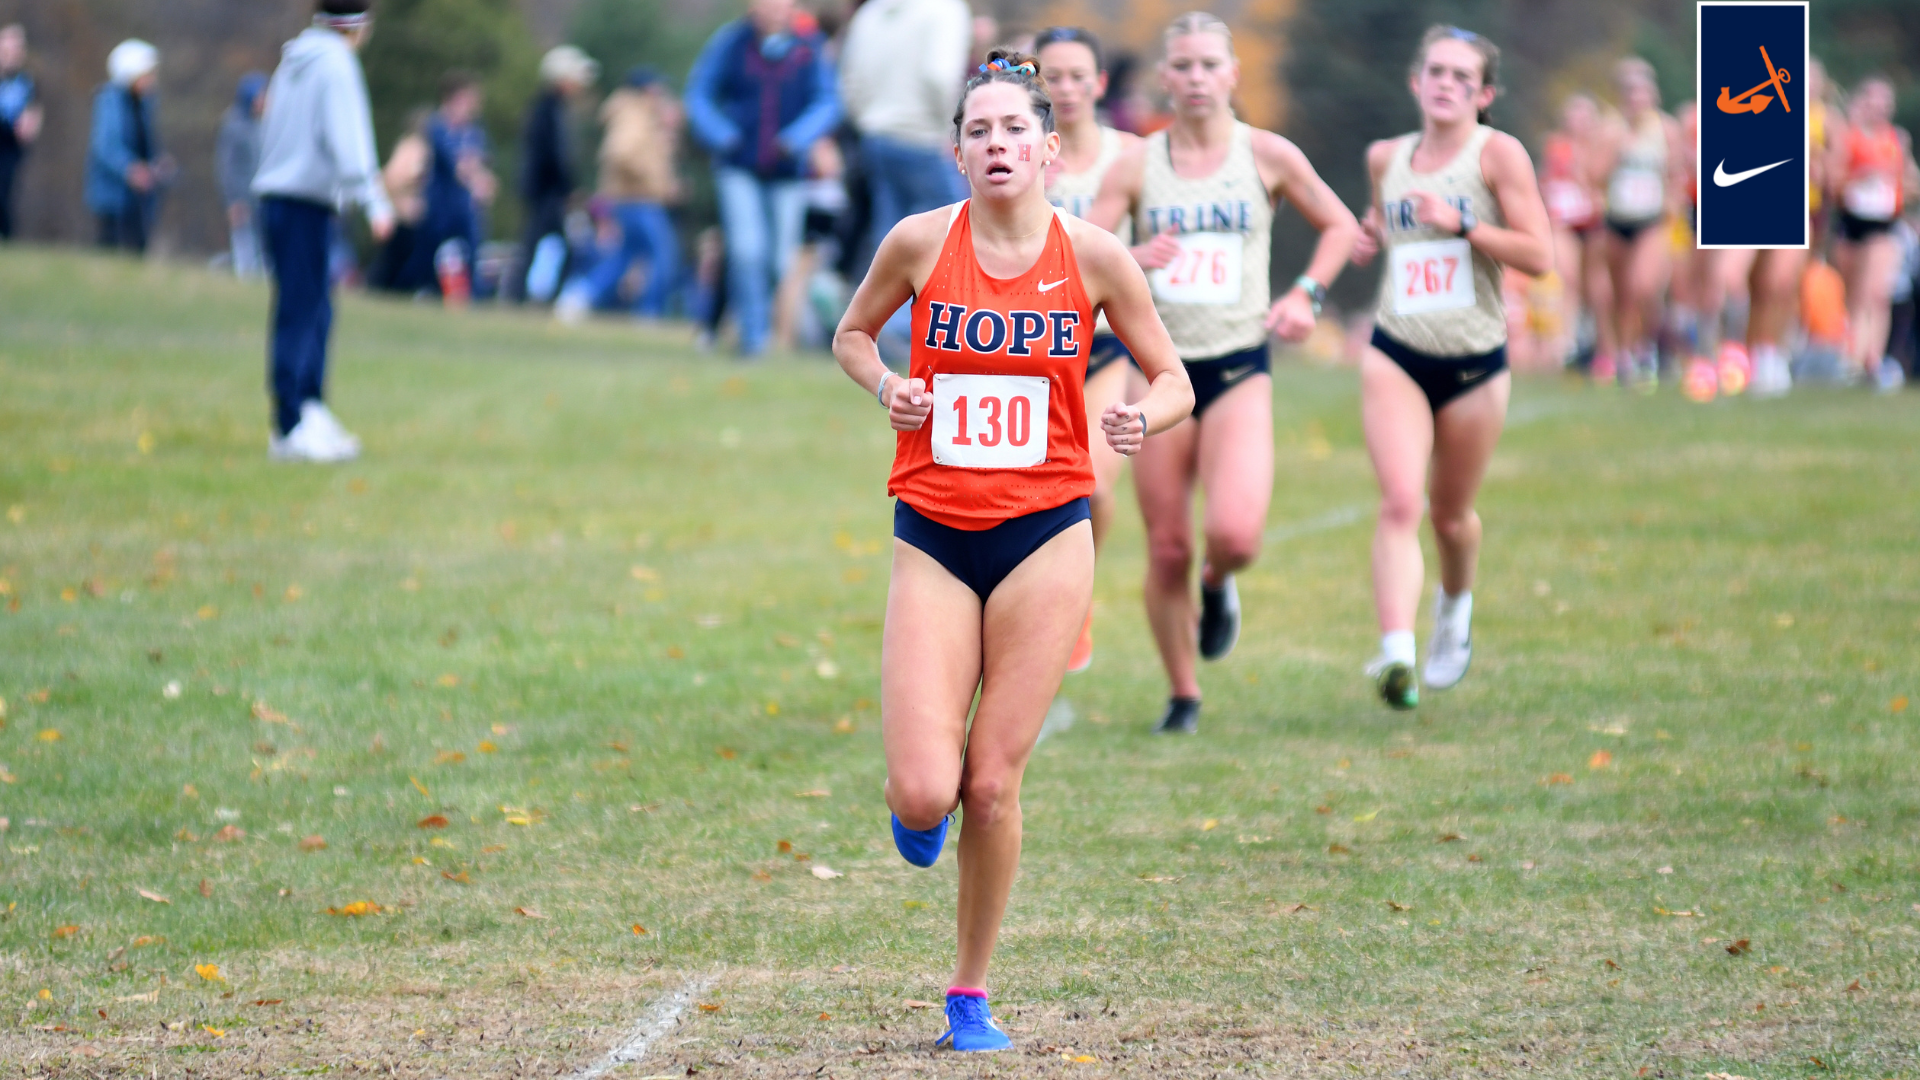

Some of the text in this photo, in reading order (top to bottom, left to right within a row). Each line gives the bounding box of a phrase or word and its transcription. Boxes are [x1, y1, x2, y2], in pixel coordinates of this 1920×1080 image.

[1018, 144, 1031, 161] H
[1148, 201, 1251, 233] TRINE
[1168, 250, 1227, 284] 276
[1406, 256, 1459, 296] 267
[925, 301, 1079, 357] HOPE
[952, 395, 1031, 447] 130
